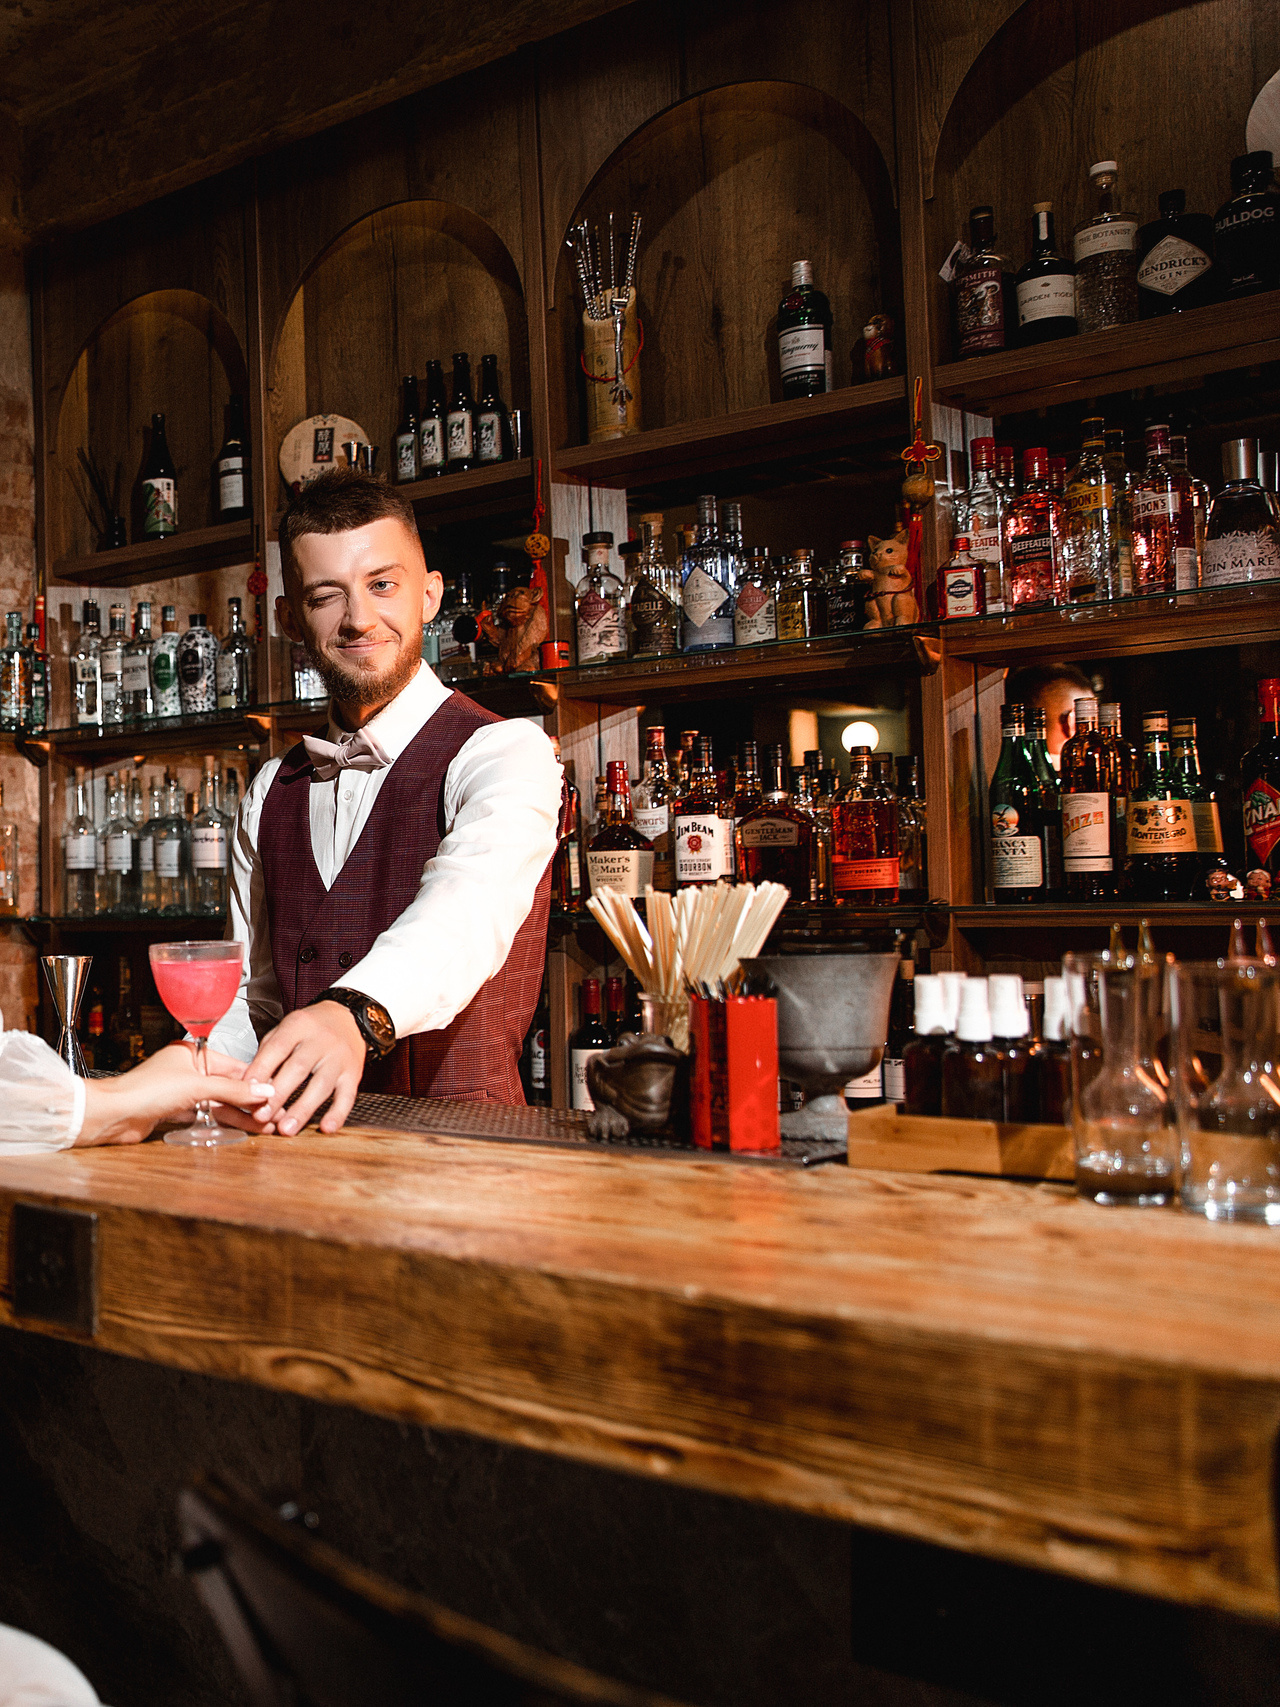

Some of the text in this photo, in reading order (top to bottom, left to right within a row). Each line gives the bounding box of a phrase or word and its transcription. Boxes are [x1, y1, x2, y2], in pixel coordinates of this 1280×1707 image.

[1092, 228, 1132, 242] BOTANIST
[1138, 256, 1207, 279] HENDRICK'S
[1159, 270, 1183, 281] GIN
[970, 536, 1000, 549] FEATER
[1206, 556, 1275, 574] GIN MARE
[676, 821, 714, 840] JIM BEAM
[745, 827, 794, 835] GENTLEMAN
[1130, 827, 1187, 840] MONTENEGRO
[589, 856, 630, 864] Maker's
[600, 865, 631, 873] Mark
[679, 863, 712, 872] BOURBON
